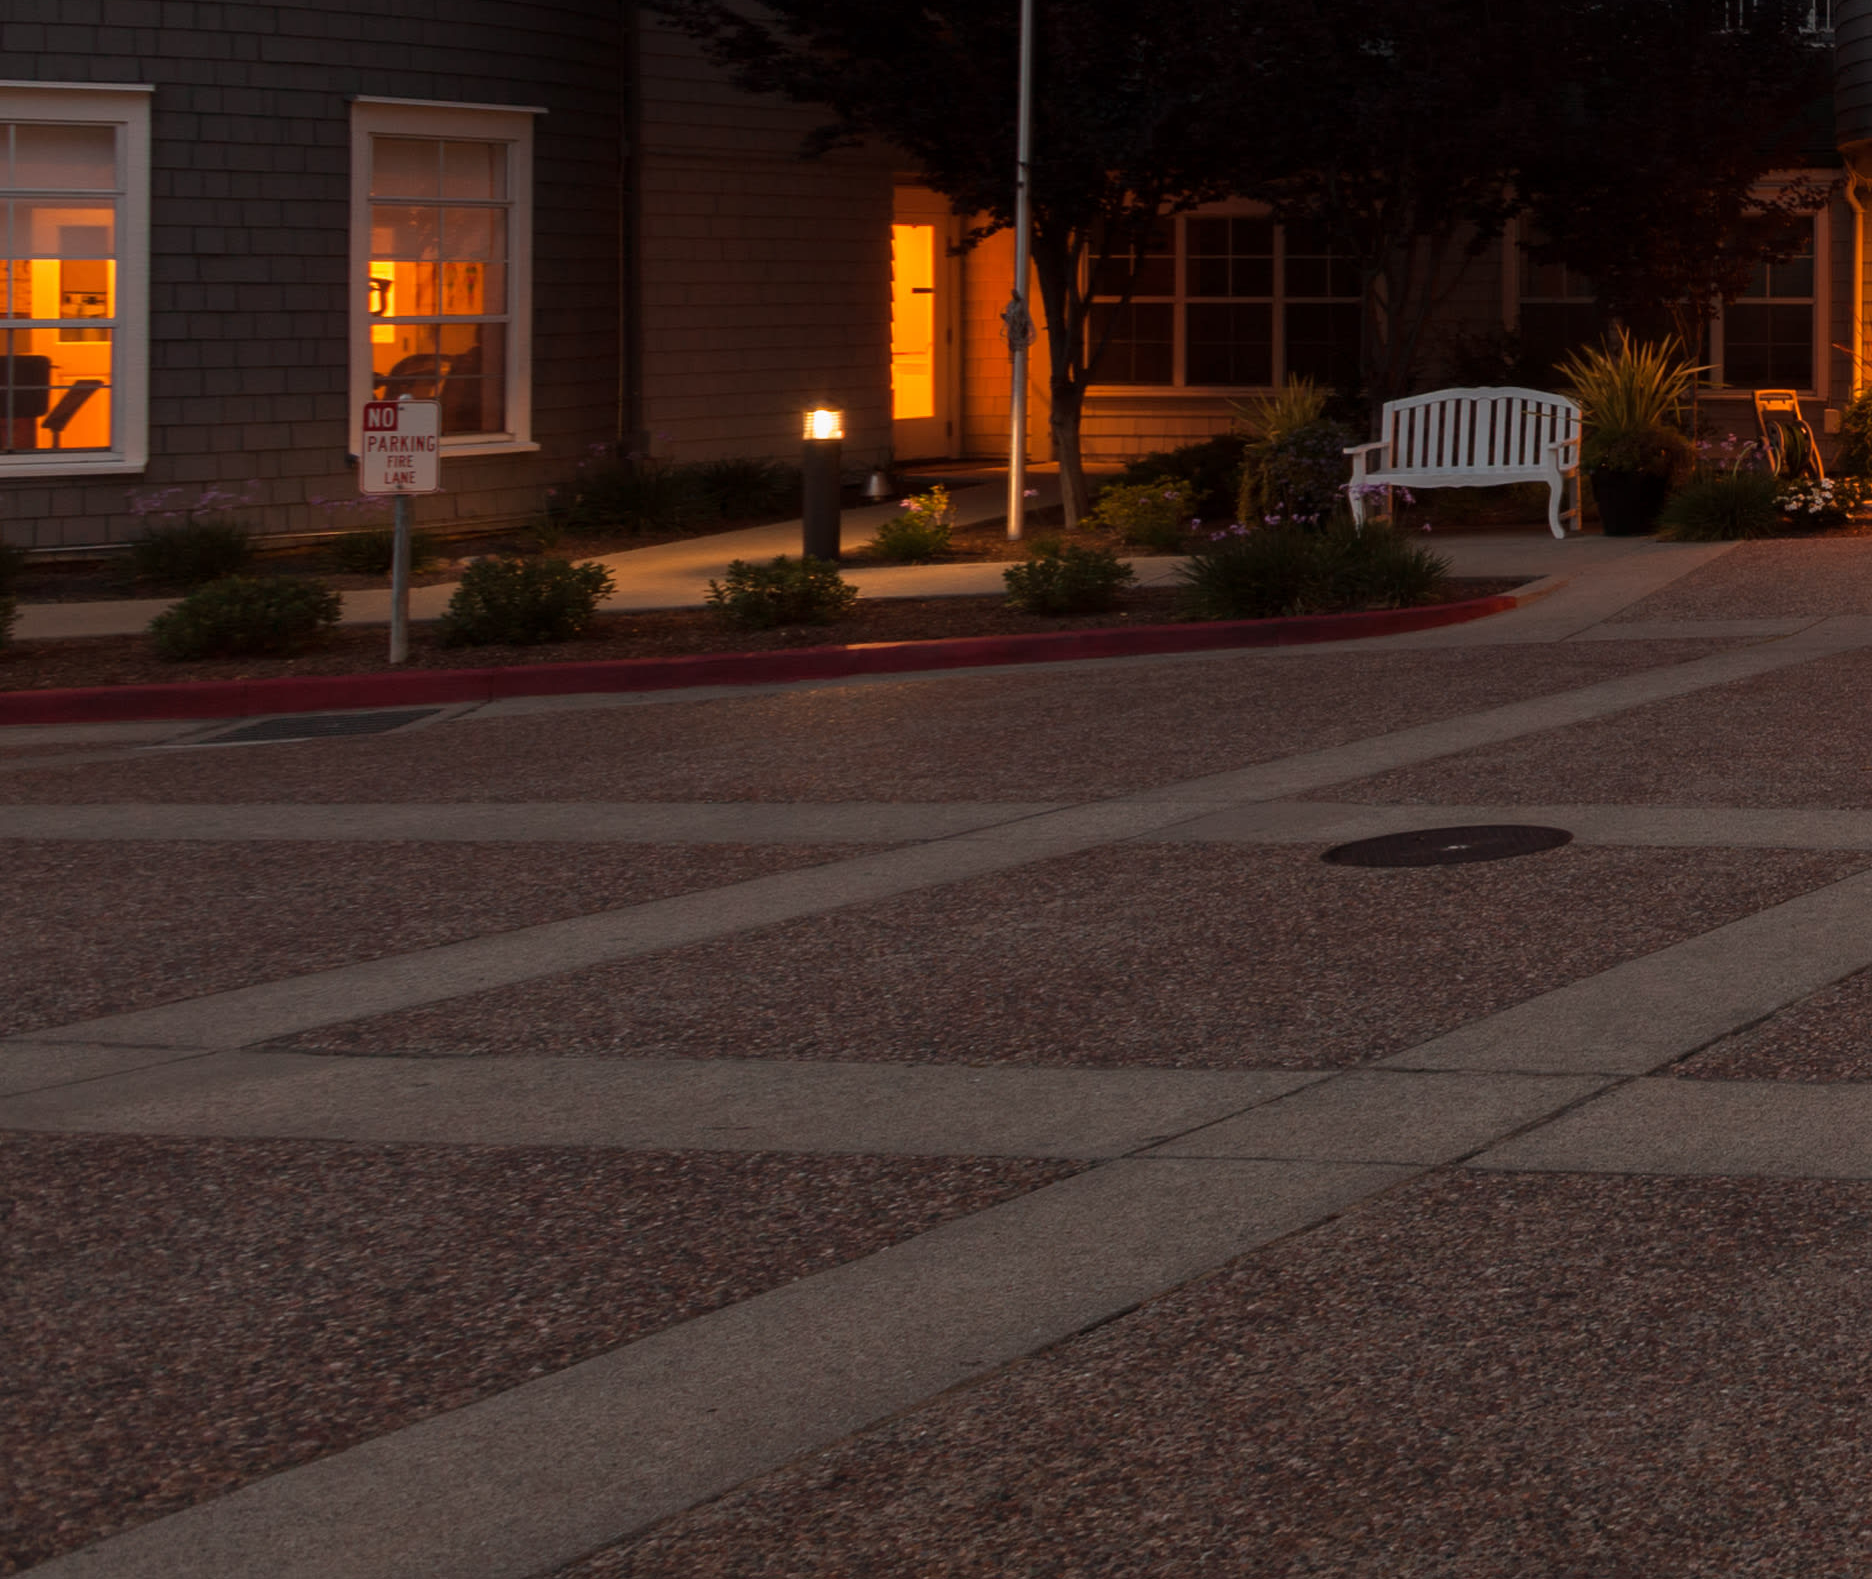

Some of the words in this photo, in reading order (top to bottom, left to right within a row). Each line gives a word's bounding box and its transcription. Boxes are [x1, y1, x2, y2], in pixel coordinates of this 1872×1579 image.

[368, 407, 394, 428] NO
[367, 435, 436, 453] PARKING
[387, 455, 415, 468] FIRE
[384, 471, 417, 484] LANE
